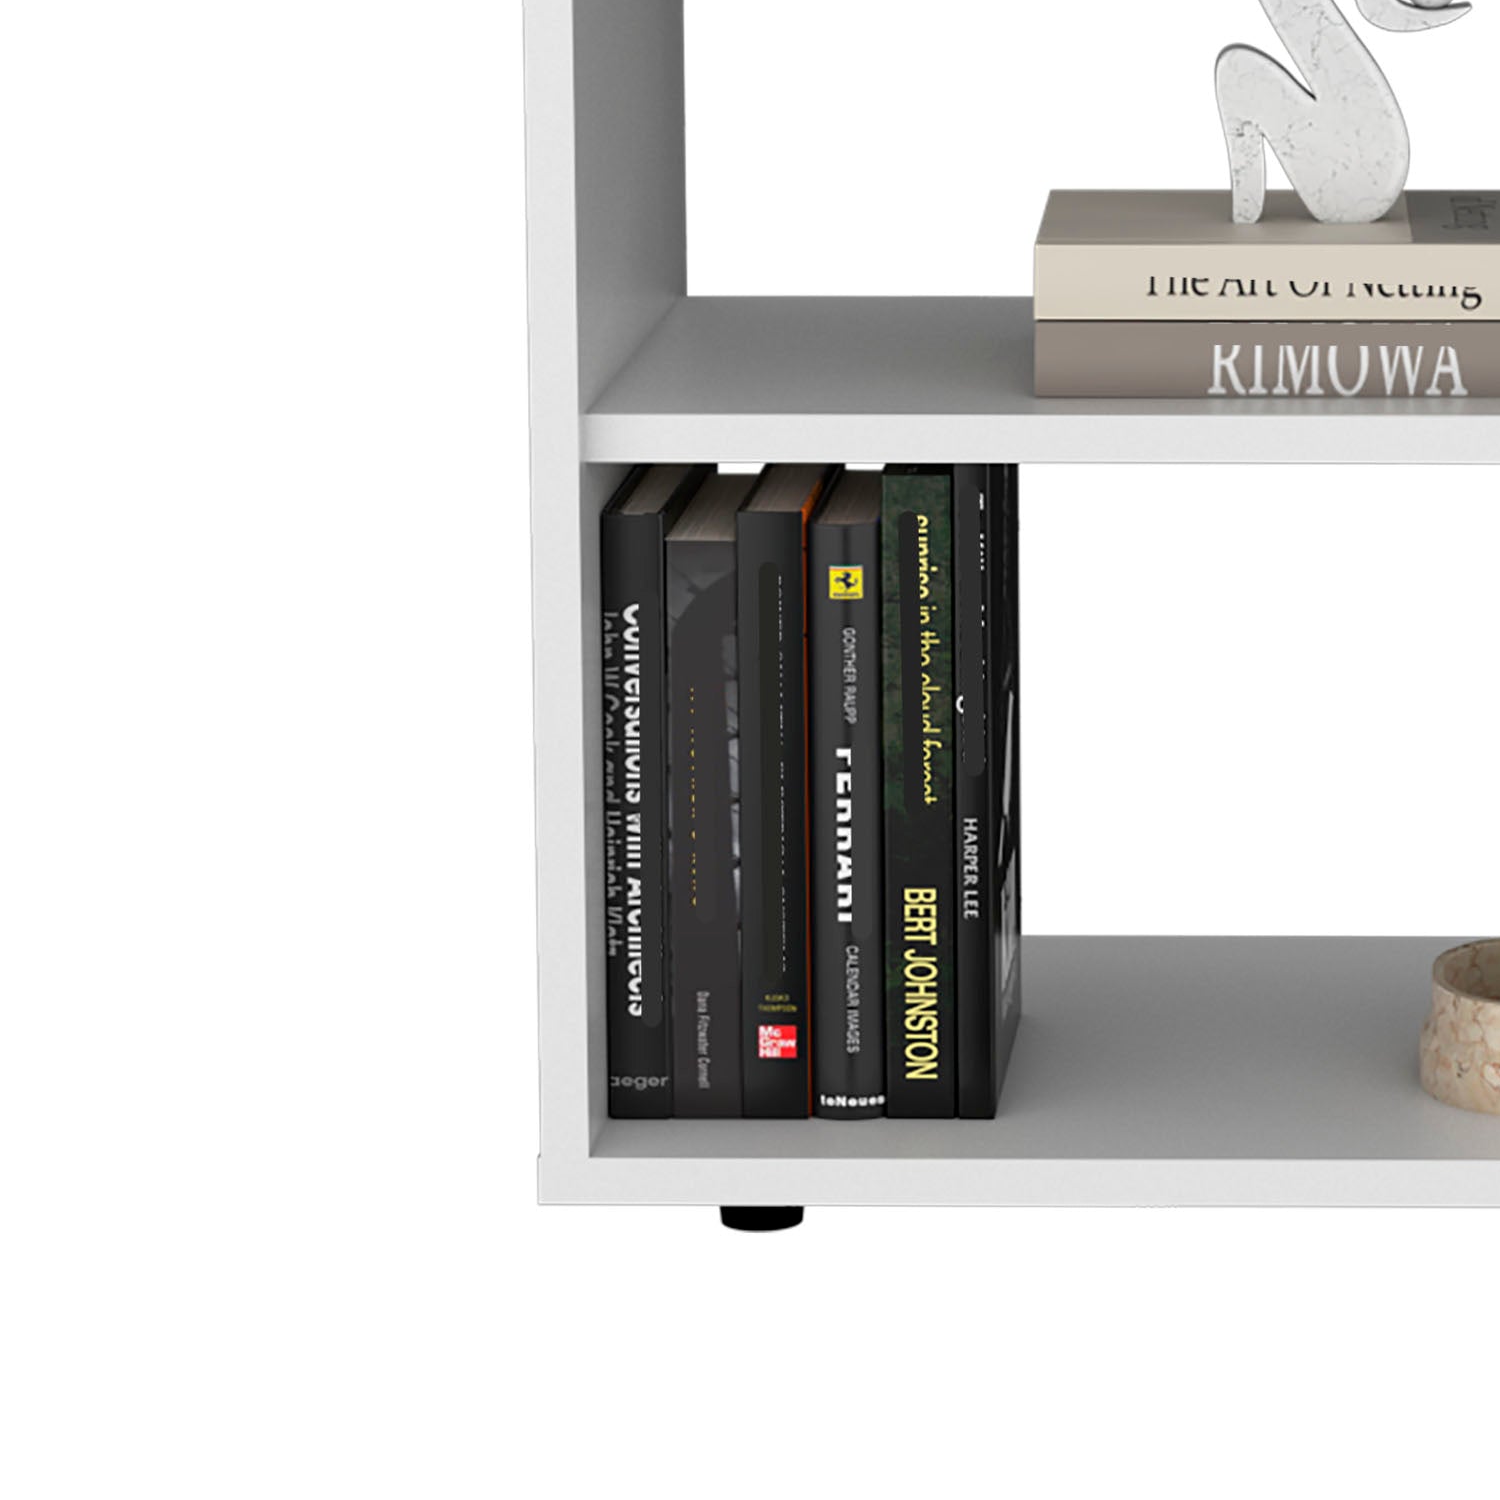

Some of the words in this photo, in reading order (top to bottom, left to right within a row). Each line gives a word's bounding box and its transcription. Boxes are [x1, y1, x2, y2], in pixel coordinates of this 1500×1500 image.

[963, 817, 979, 885] HARPER
[903, 887, 937, 946] BERT
[963, 890, 979, 920] LEE
[903, 948, 939, 1080] JOHNSTON
